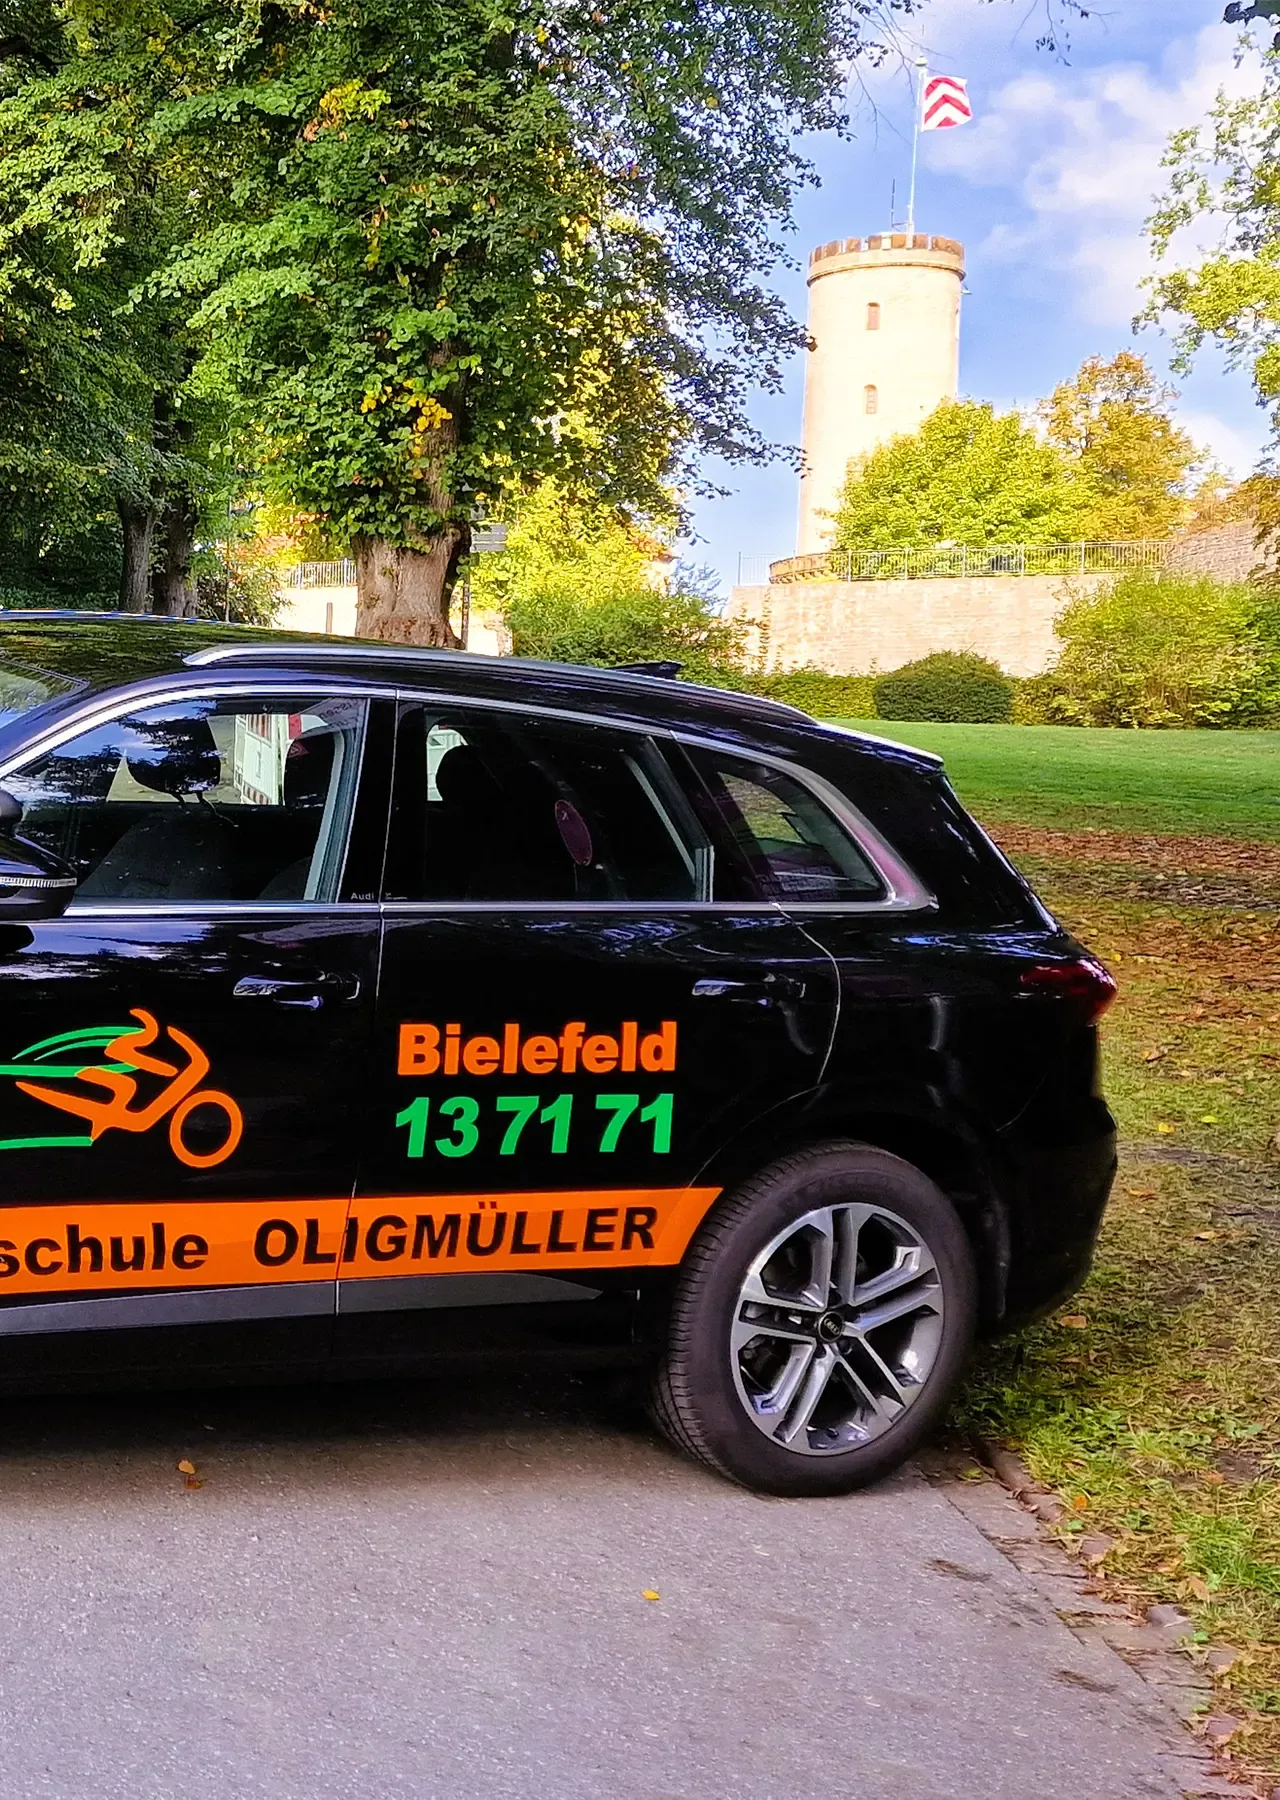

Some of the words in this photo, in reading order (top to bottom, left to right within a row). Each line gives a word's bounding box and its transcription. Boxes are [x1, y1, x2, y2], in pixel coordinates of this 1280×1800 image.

[350, 892, 374, 900] Audi
[397, 1021, 677, 1075] Bielefeld
[395, 1096, 480, 1158] 13
[496, 1094, 573, 1155] 71
[595, 1093, 674, 1154] 71
[253, 1200, 659, 1267] OLIGMÜLLER
